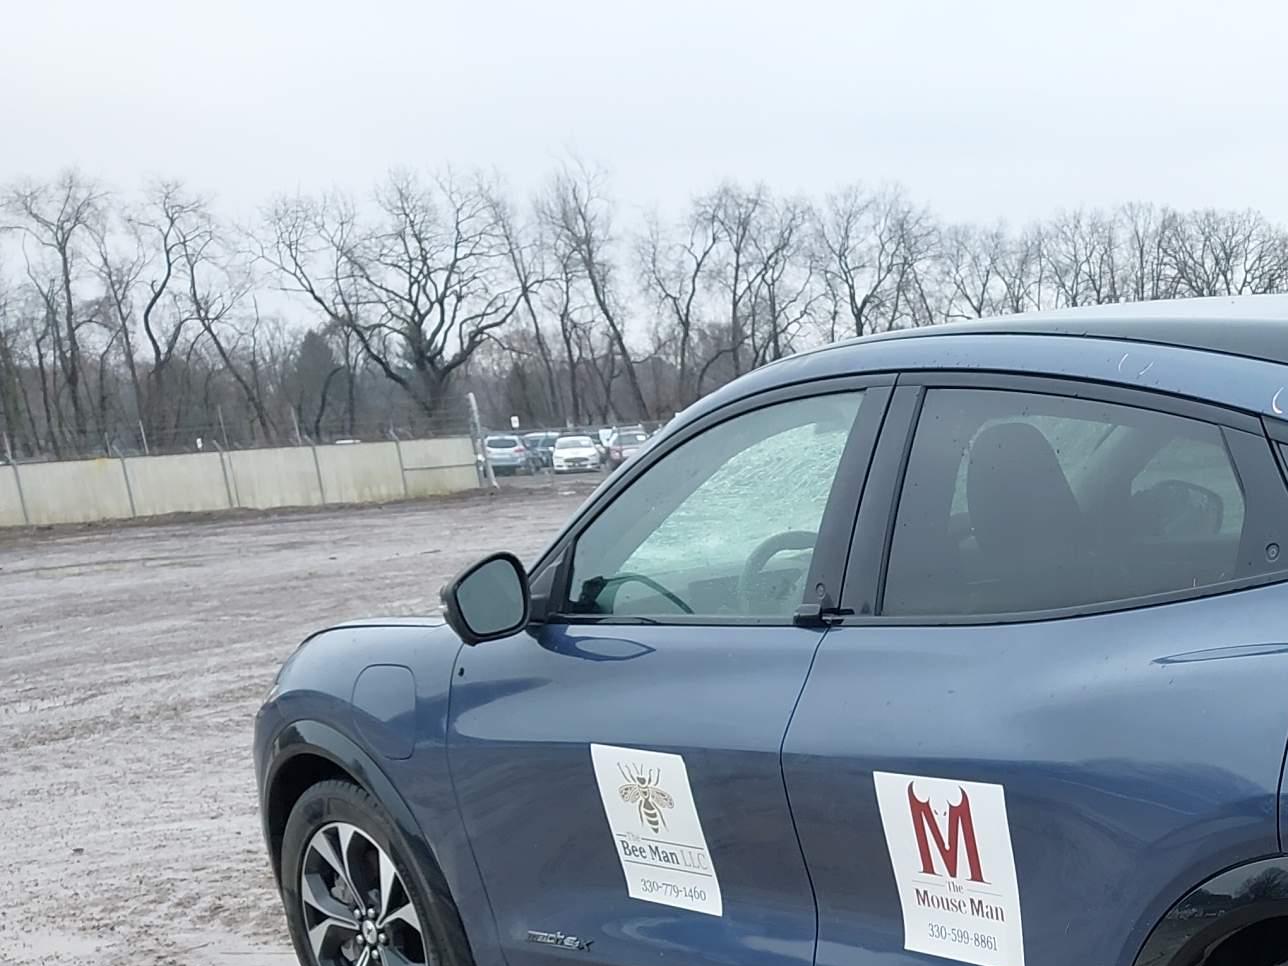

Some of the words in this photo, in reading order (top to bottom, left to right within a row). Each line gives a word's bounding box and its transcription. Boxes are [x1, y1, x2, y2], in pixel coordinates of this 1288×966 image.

[620, 839, 647, 859] Bee
[648, 844, 680, 865] Man
[680, 850, 708, 870] LLC
[640, 878, 707, 902] 330-779-1460
[946, 880, 964, 894] The
[915, 888, 968, 915] Mouse
[969, 898, 1005, 922] Man
[928, 922, 998, 951] 330-599-8861
